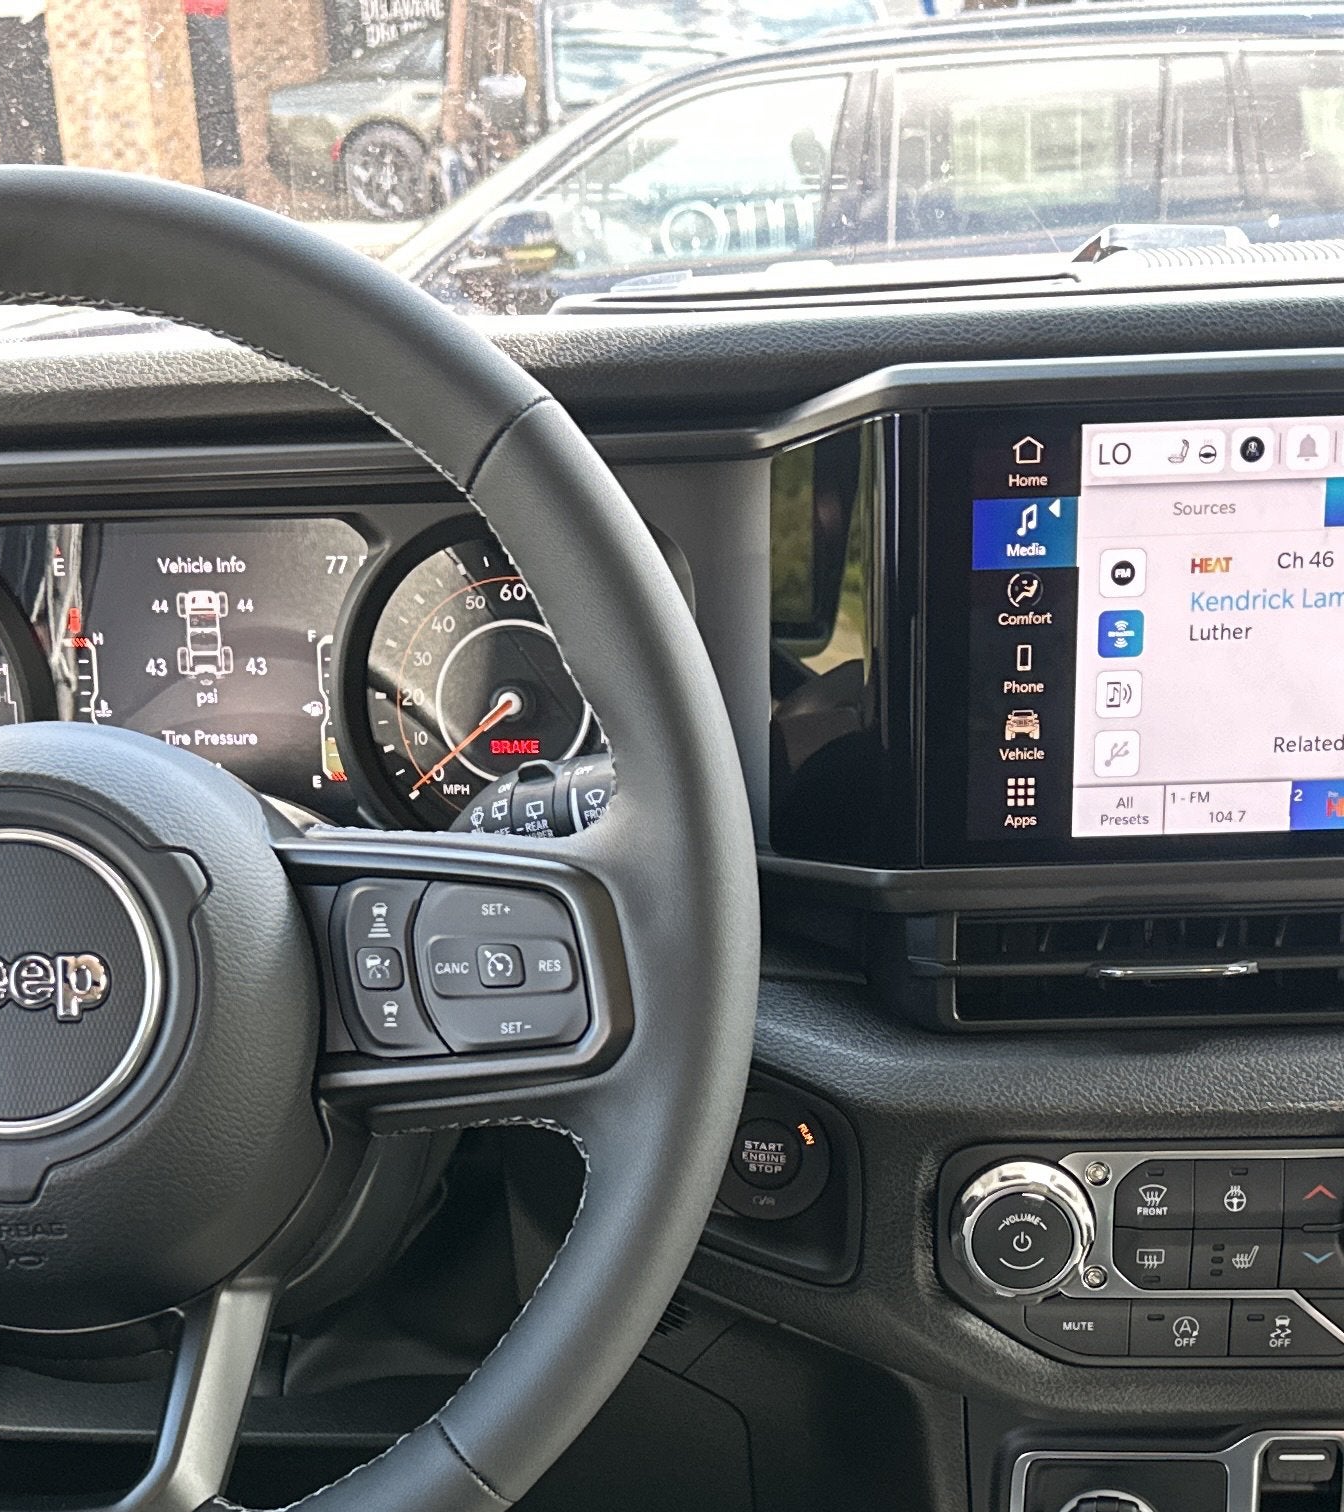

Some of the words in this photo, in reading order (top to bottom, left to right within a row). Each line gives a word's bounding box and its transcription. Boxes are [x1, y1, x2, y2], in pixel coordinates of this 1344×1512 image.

[1098, 443, 1132, 466] LO
[1008, 474, 1048, 488] Home
[1172, 501, 1237, 517] Sources
[1006, 542, 1046, 557] Media
[156, 557, 212, 573] Vehicle
[216, 557, 246, 573] Info
[325, 556, 348, 574] 77
[1190, 557, 1233, 574] HEAT
[1277, 551, 1304, 570] Ch
[1309, 550, 1335, 569] 46
[499, 583, 527, 601] 60
[152, 600, 168, 613] 44
[237, 599, 254, 612] 44
[465, 596, 486, 610] 50
[1189, 587, 1294, 613] Kendrick
[431, 616, 455, 633] 40
[998, 611, 1052, 627] Comfort
[93, 633, 103, 645] H
[308, 630, 317, 642] F
[1189, 624, 1253, 641] Luther
[413, 652, 432, 666] 30
[145, 658, 167, 676] 43
[246, 658, 267, 675] 43
[1003, 680, 1045, 694] Phone
[196, 688, 218, 707] psi
[402, 688, 424, 706] 20
[161, 730, 191, 746] Tire
[195, 730, 257, 746] Pressure
[413, 731, 428, 746] 10
[490, 739, 540, 755] BRAKE
[999, 747, 1045, 761] Vehicle
[432, 764, 444, 781] 0
[313, 775, 321, 787] E
[443, 784, 470, 795] MPH
[1294, 789, 1303, 801] 2
[1116, 797, 1133, 809] All
[1189, 791, 1210, 803] FM
[525, 819, 548, 832] REAR
[1004, 814, 1038, 829] Apps
[1101, 813, 1149, 825] Presets
[435, 962, 469, 974] CANC
[538, 960, 561, 972] RES
[744, 1140, 784, 1152] START
[742, 1152, 787, 1163] ENGINE
[749, 1163, 782, 1174] STOP
[1136, 1206, 1168, 1216] FRONT
[1002, 1213, 1042, 1226] VOLUME
[1062, 1321, 1094, 1331] MUTE
[1174, 1337, 1196, 1347] OFF
[1268, 1338, 1292, 1348] OFF
